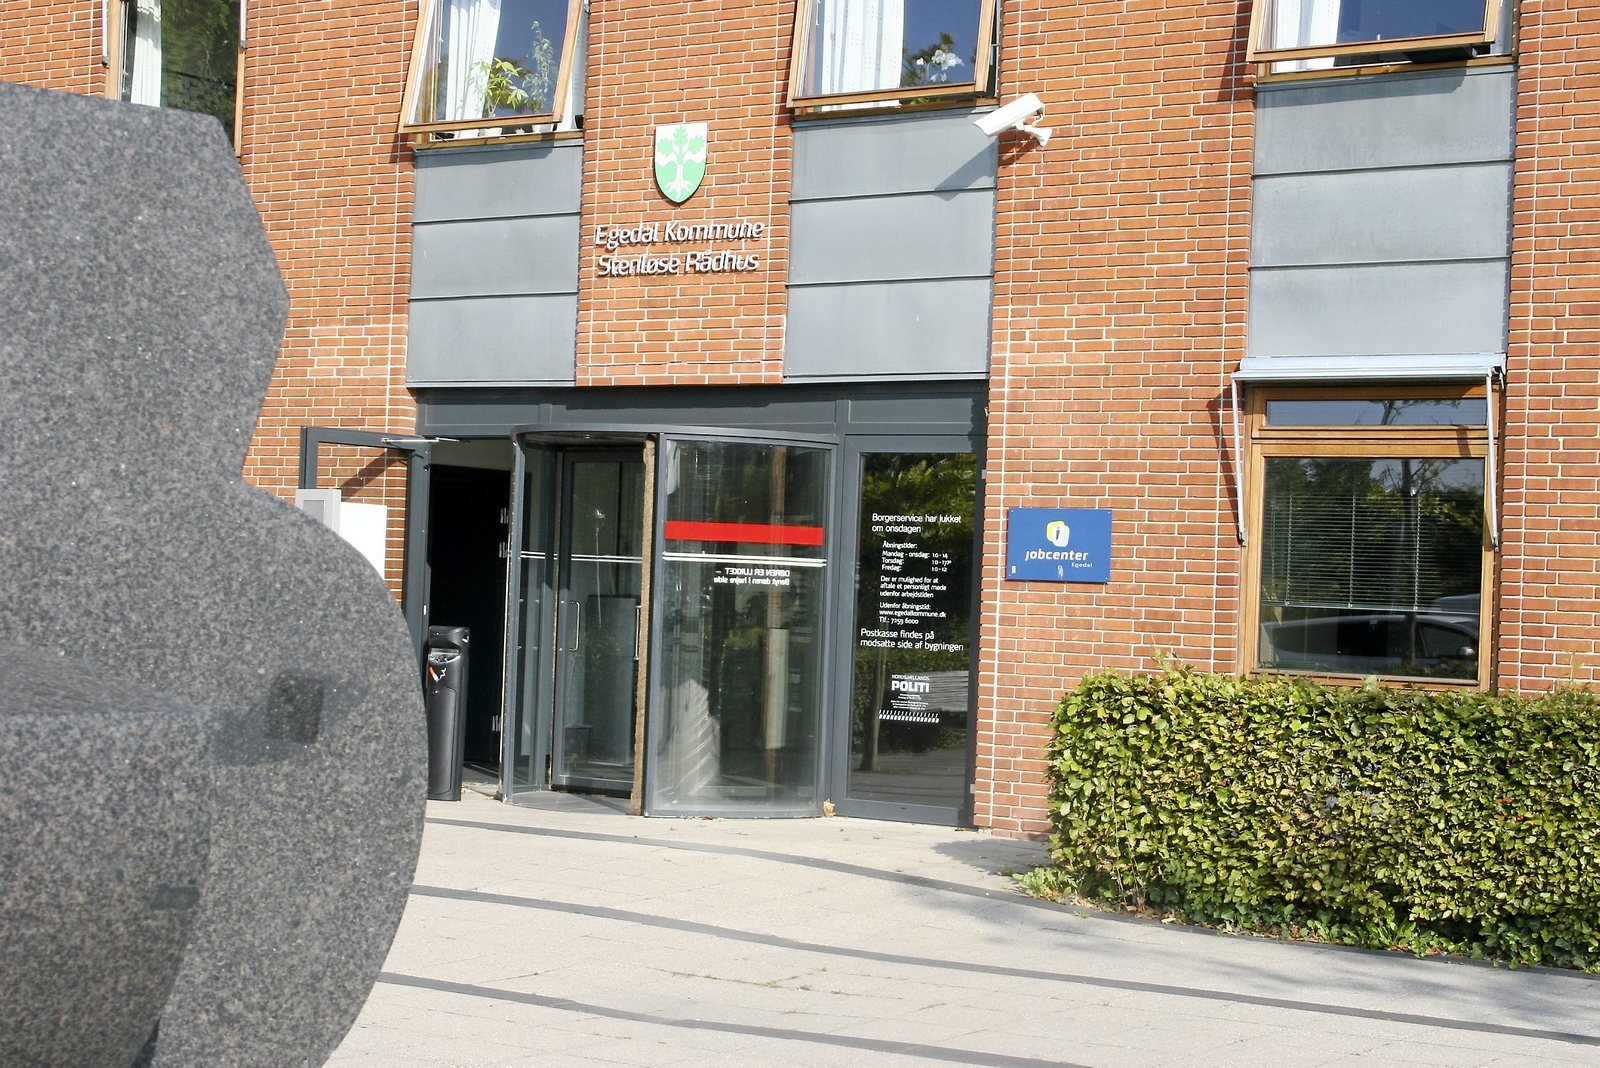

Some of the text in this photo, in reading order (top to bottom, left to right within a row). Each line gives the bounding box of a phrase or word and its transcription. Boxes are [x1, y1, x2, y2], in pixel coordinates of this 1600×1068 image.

[595, 221, 765, 249] Egedal Kommune
[598, 250, 760, 276] Stenløse Rådhus
[872, 513, 961, 523] Borgerservice har lukket
[886, 524, 922, 534] onsdagen
[882, 540, 918, 549] Åbningstider:
[1025, 548, 1088, 561] jobcenter
[860, 628, 934, 640] Postkasse findes på
[860, 639, 895, 647] modsatte
[897, 640, 912, 648] side
[925, 641, 963, 652] bygningen
[891, 680, 929, 692] POLITI
